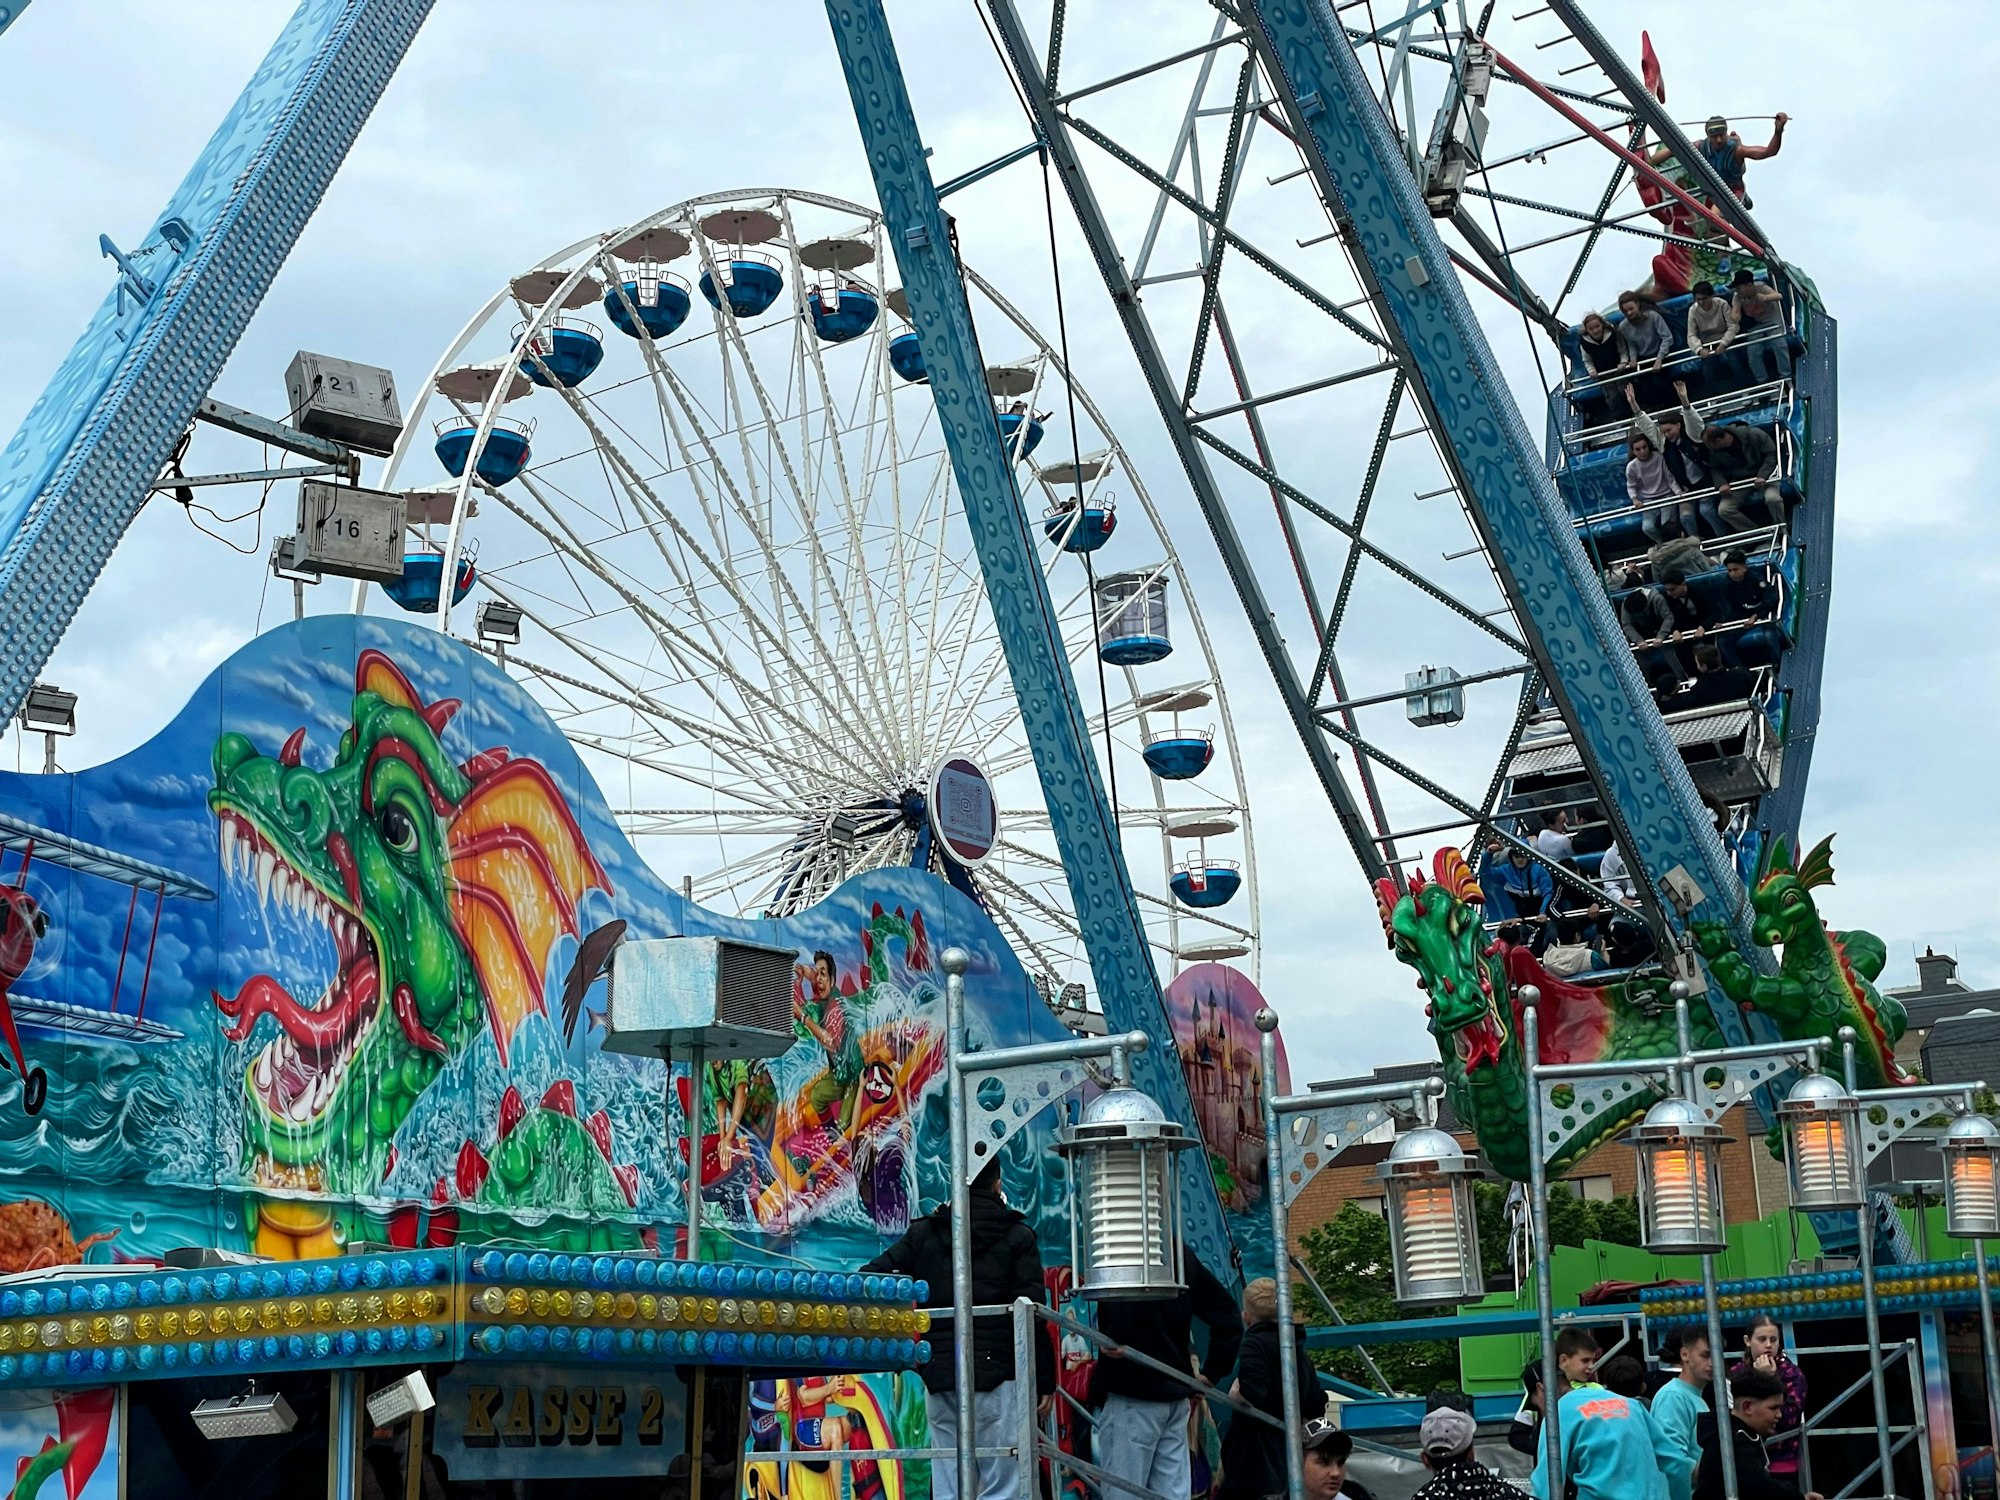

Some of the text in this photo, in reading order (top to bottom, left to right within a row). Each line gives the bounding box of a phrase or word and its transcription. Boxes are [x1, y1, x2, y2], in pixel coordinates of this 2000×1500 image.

[329, 376, 355, 394] 21
[334, 518, 360, 538] 16
[463, 1385, 664, 1446] KASSE 2
